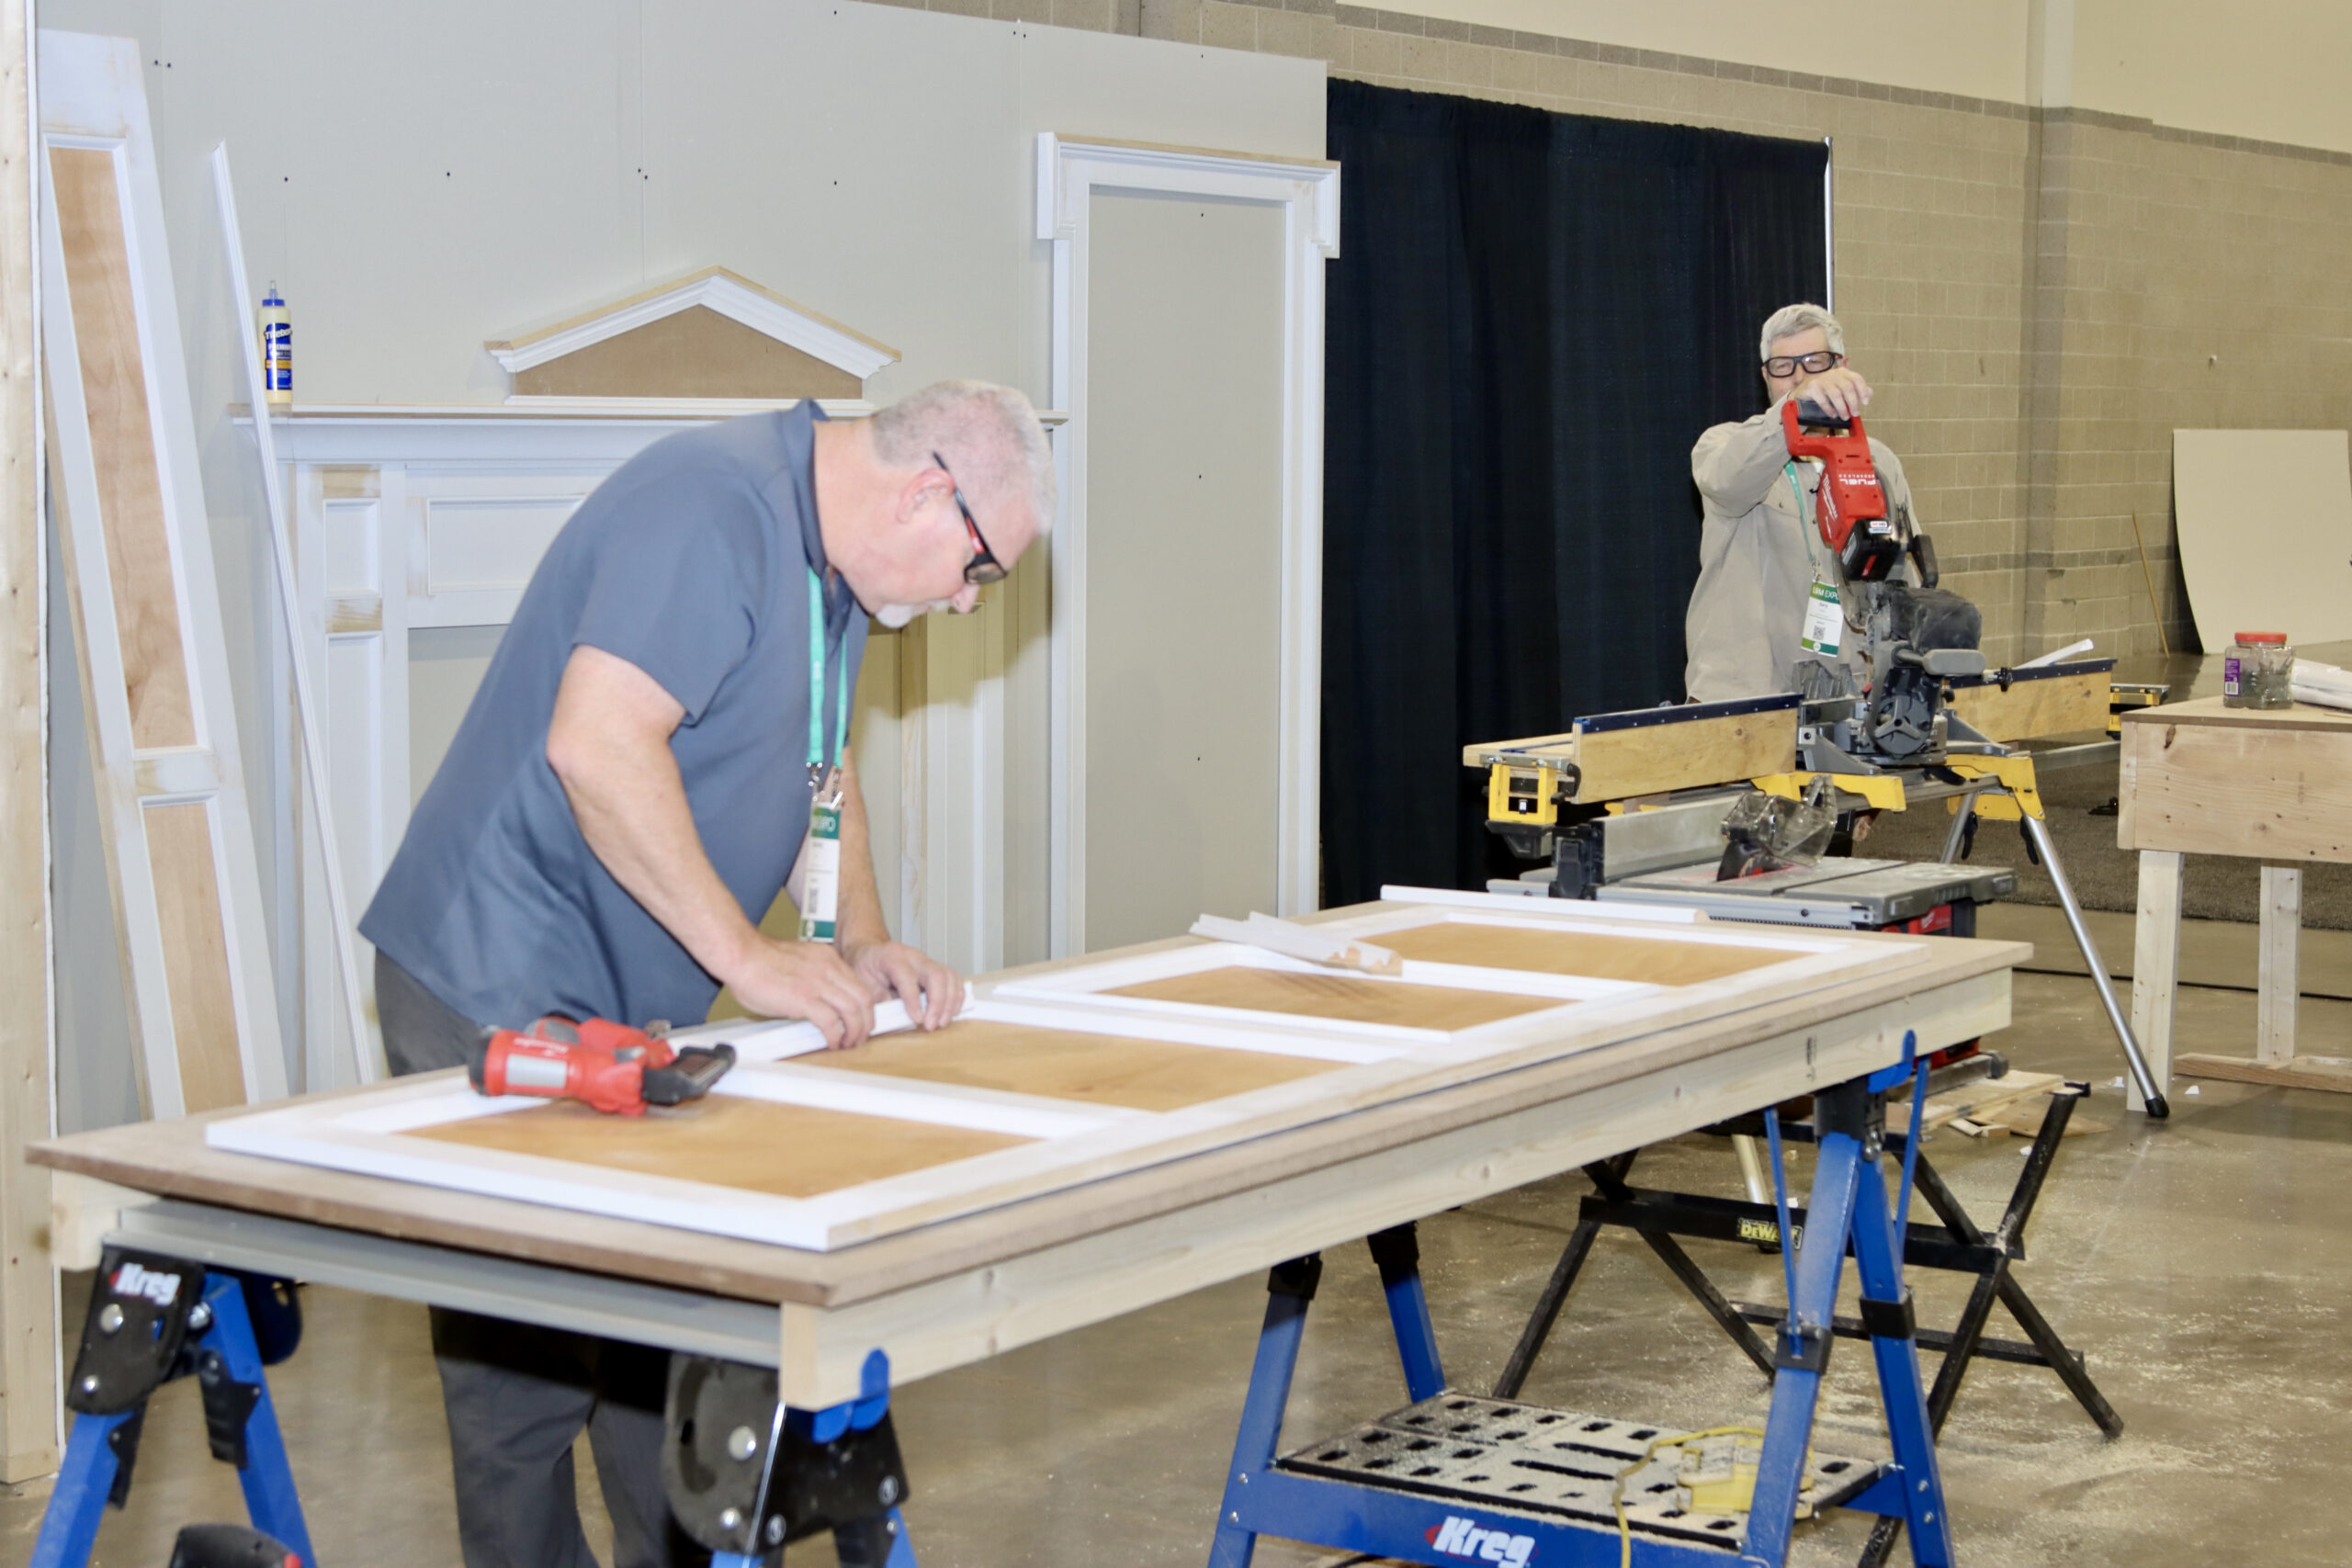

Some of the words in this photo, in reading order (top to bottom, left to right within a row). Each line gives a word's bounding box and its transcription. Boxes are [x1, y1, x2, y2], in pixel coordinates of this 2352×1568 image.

[1741, 1223, 1798, 1242] DEWAT
[116, 1262, 182, 1306] Kreg
[1432, 1515, 1536, 1568] Kreg
